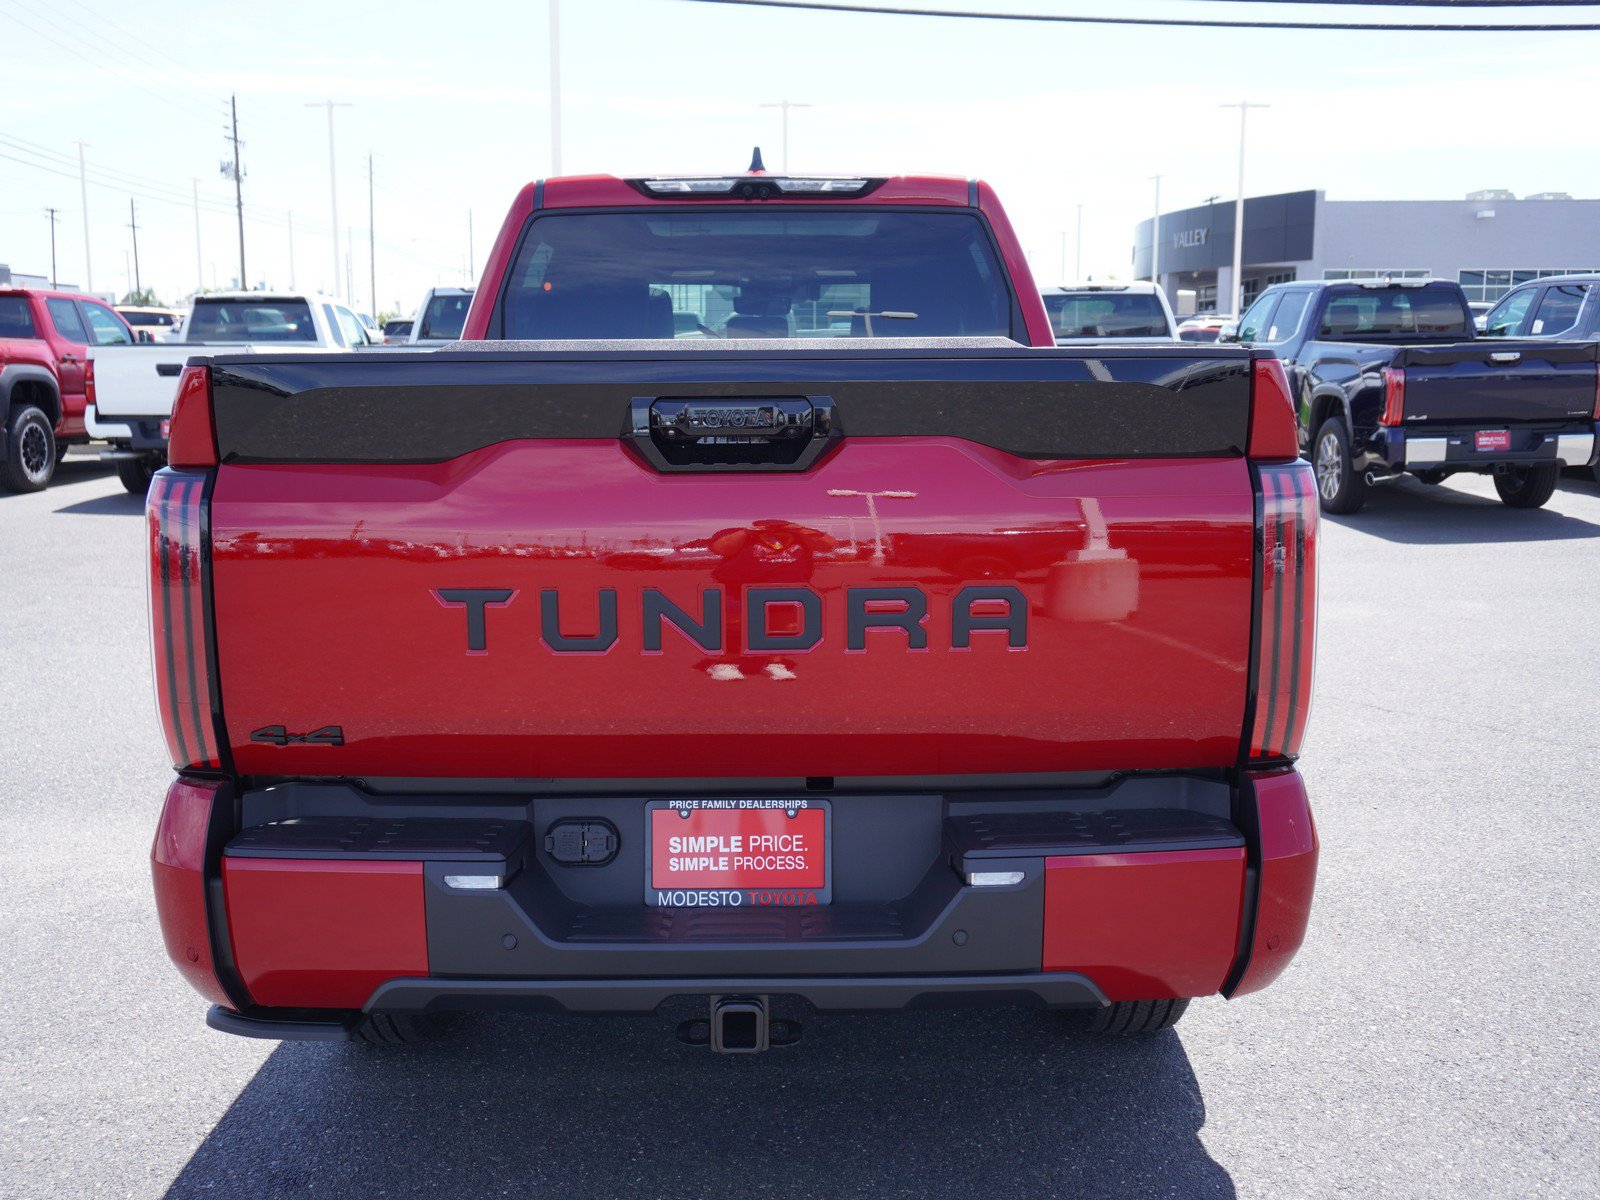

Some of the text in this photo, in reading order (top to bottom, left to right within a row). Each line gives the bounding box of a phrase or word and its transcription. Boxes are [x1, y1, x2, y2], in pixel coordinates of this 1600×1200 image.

[1173, 228, 1208, 249] VALLEY
[694, 409, 772, 427] TOYOTA
[429, 586, 1030, 656] TUNDRA
[669, 800, 808, 809] PRICE FAMILY DEALERSHIPS
[669, 835, 809, 853] SIMPLE PRICE.
[669, 856, 809, 871] SIMPLE PROCESS.
[658, 891, 817, 906] MODESTO TOYOTA
